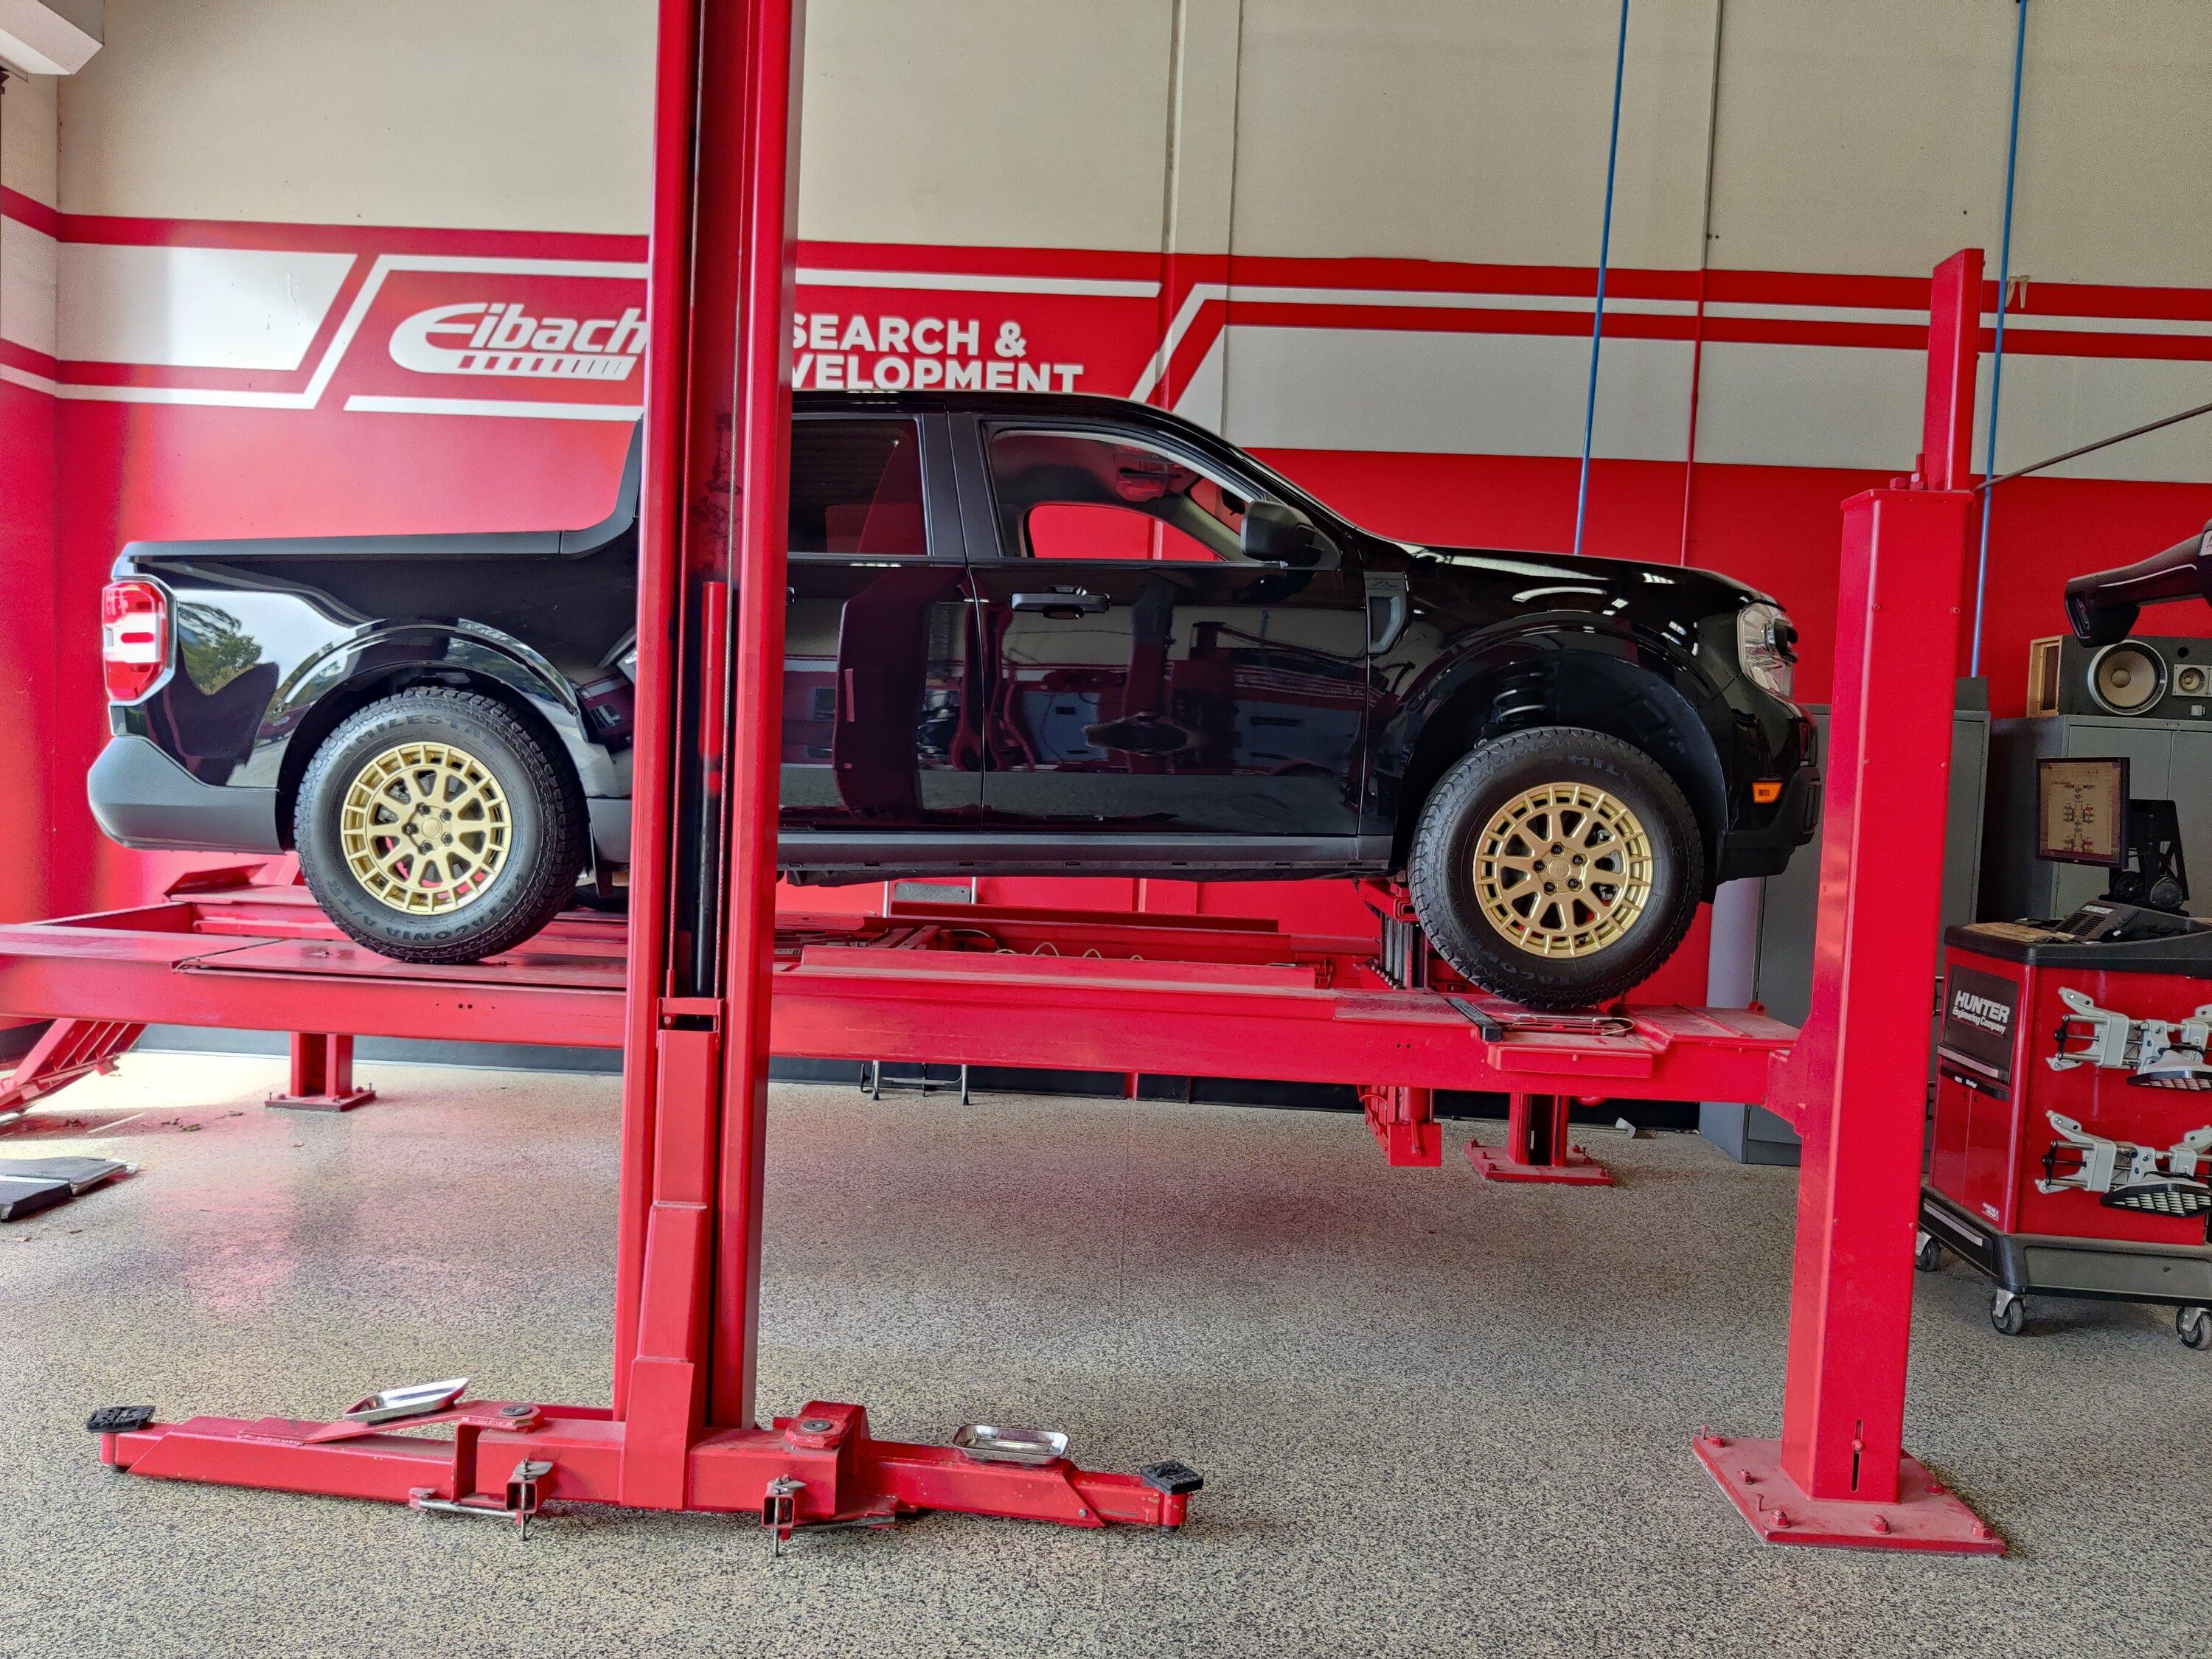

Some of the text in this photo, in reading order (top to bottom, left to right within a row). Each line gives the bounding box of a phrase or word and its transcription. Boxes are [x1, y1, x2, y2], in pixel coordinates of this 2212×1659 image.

[389, 302, 648, 380] Eibach
[994, 319, 1028, 358] &
[1952, 1006, 2006, 1034] Engineering Company
[1955, 990, 2010, 1023] HUNTER
